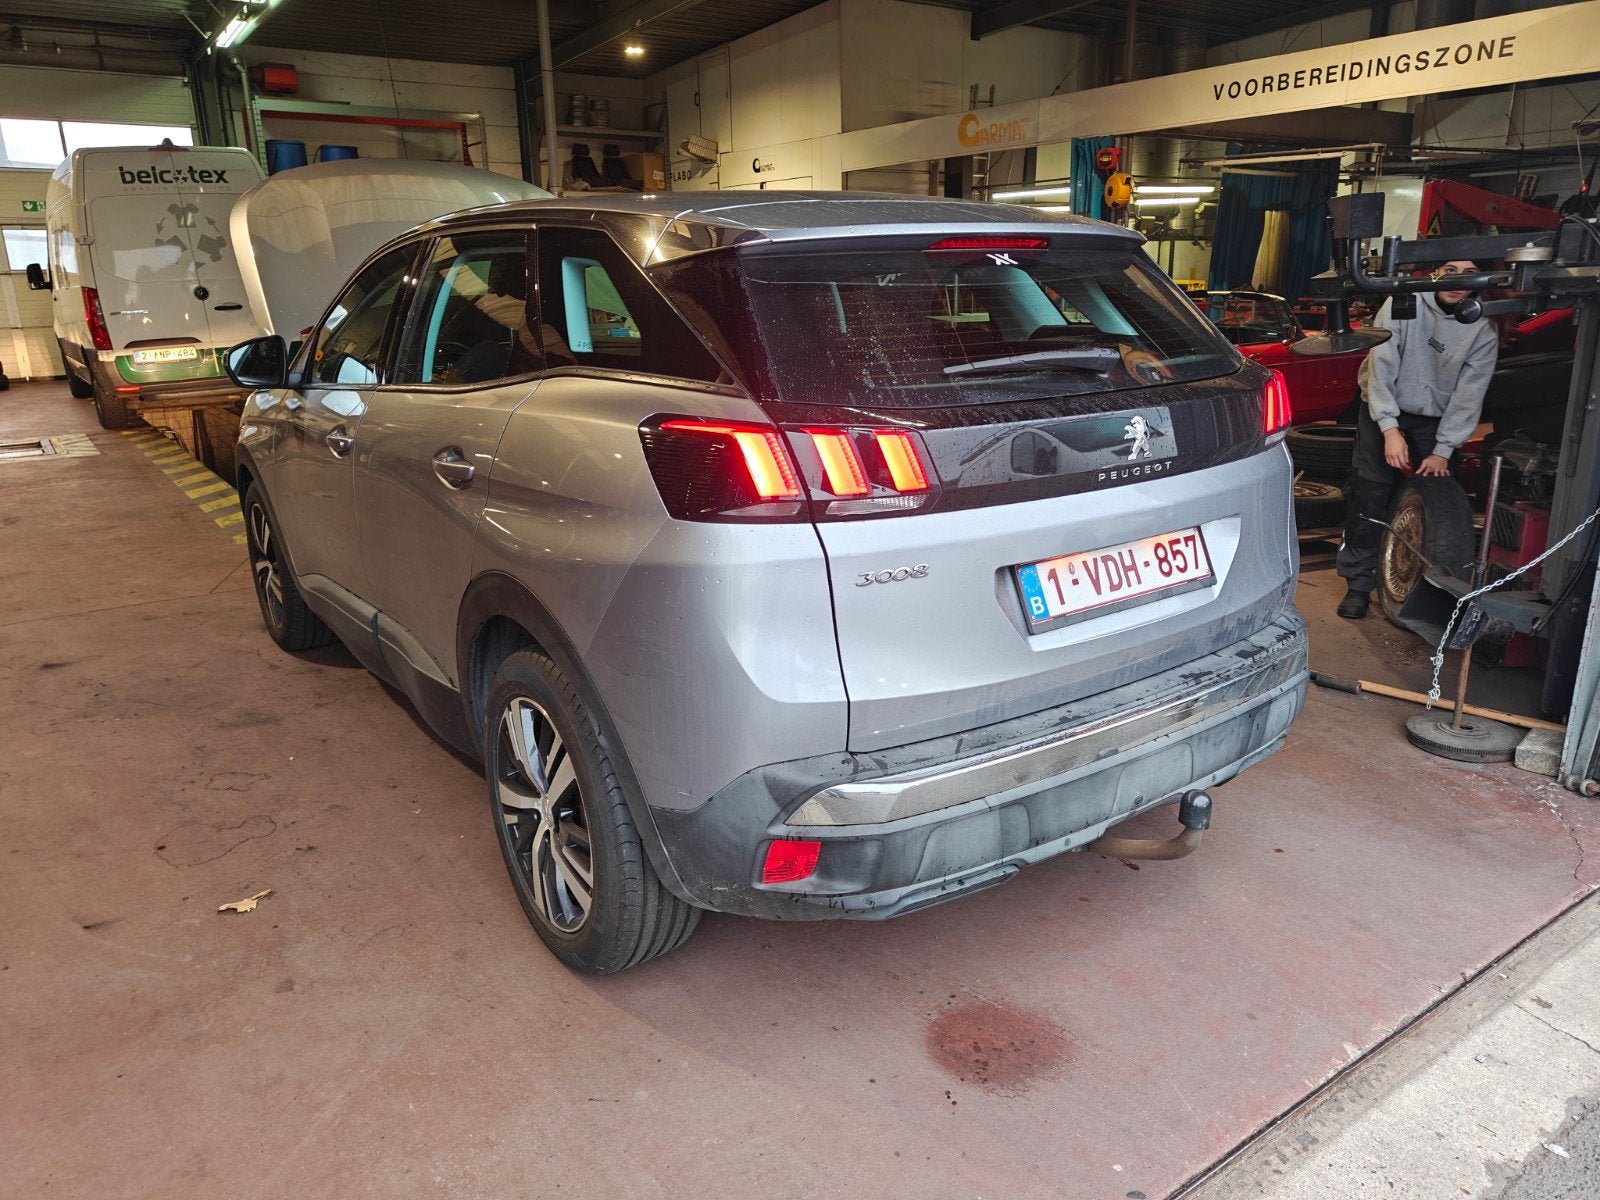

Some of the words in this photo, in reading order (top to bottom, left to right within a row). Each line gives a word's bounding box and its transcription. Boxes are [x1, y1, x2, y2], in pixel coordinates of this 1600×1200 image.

[1213, 35, 1517, 101] VOORBEREIDINGSZONE
[957, 113, 1032, 148] CARMAT
[1098, 460, 1172, 482] PEUGEOT
[855, 563, 929, 587] 3008
[1029, 596, 1046, 616] B
